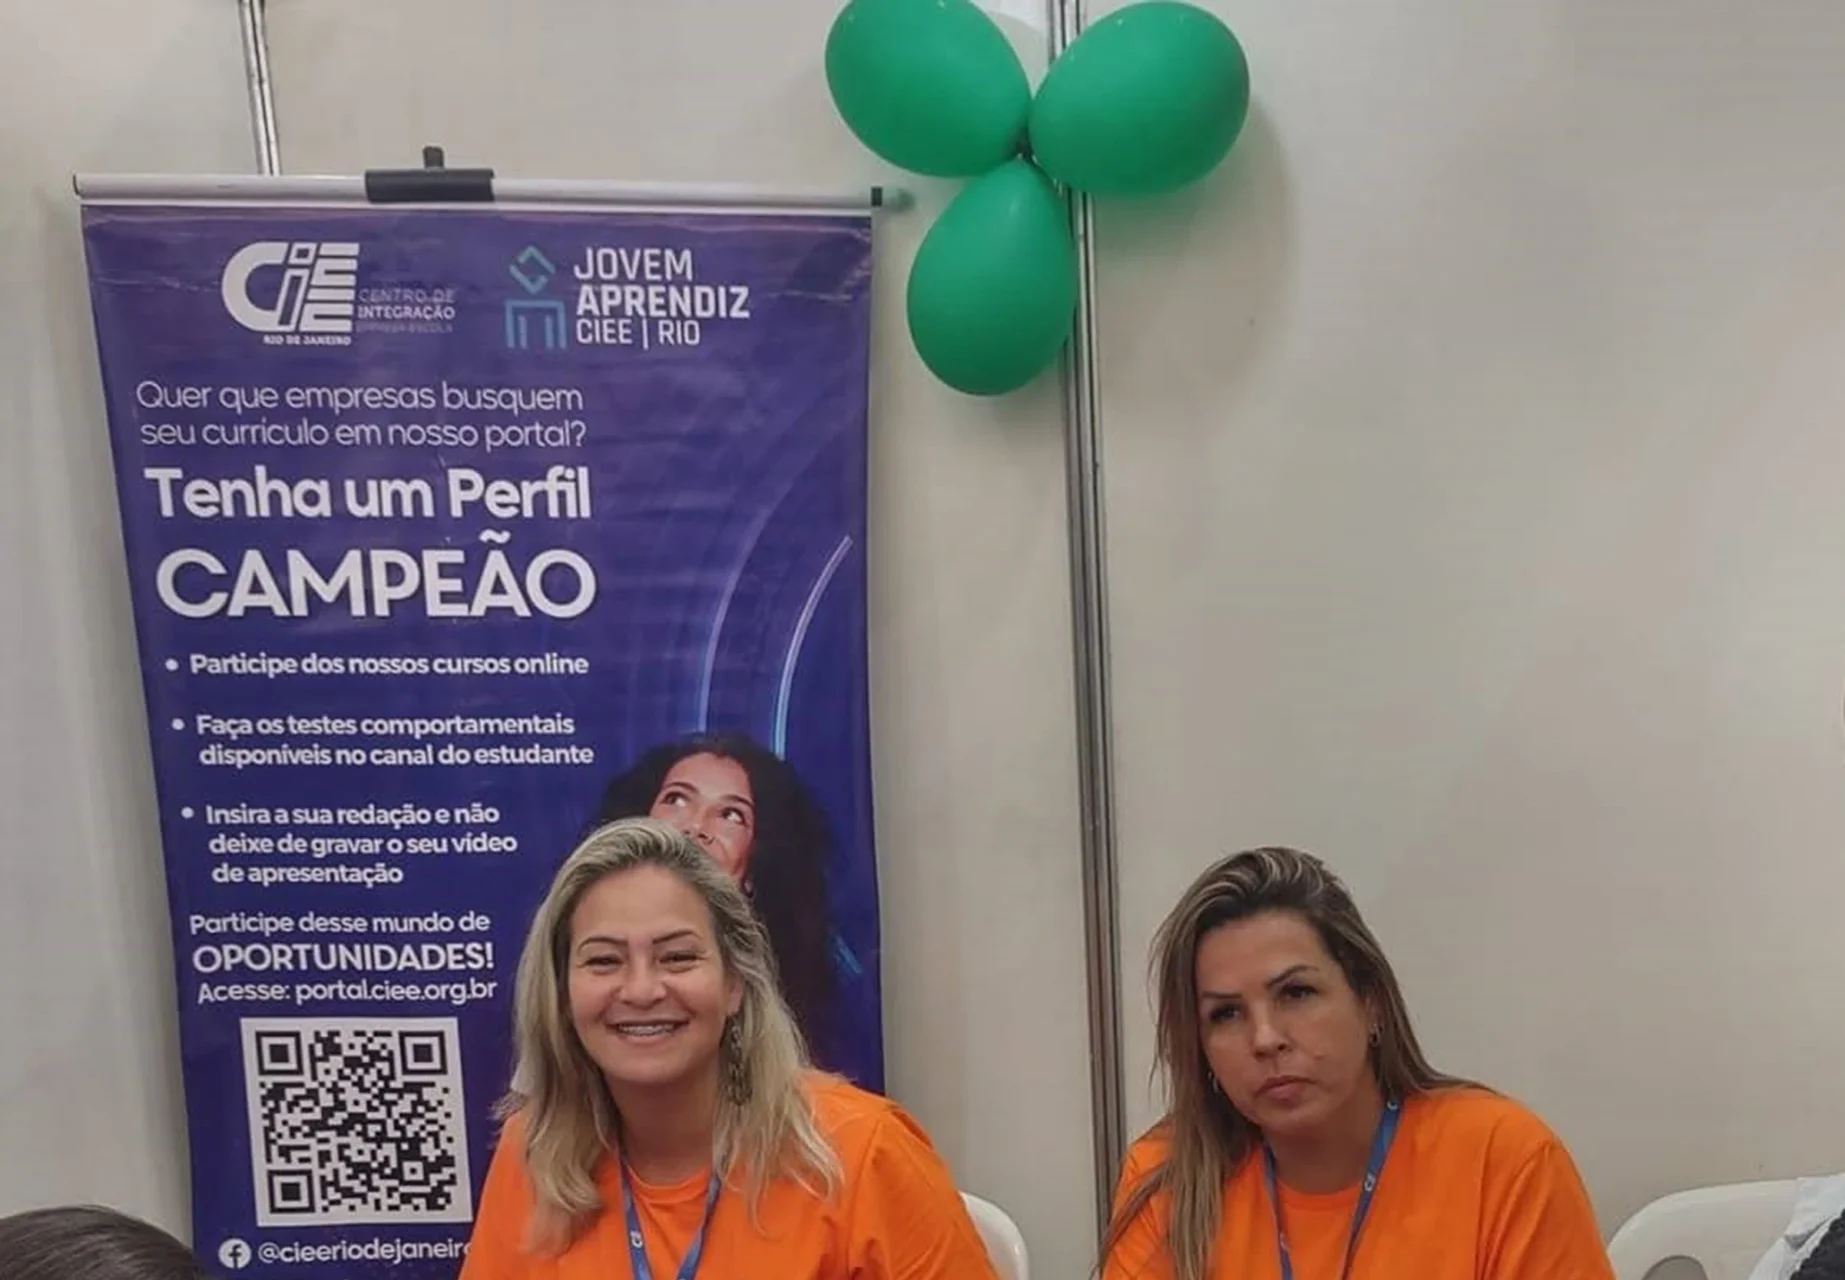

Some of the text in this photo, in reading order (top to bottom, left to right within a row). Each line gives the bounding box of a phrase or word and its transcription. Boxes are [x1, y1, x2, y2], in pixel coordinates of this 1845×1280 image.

[574, 247, 693, 281] JOVEM
[358, 288, 456, 304] CENTRO DE
[576, 284, 751, 318] APRENDIZ
[357, 305, 456, 319] INTEGRAÇÃO
[263, 335, 351, 346] RIO DE JANEIRO
[576, 318, 700, 345] CIEE RIO
[136, 380, 584, 416] Quer que empresas busquem
[140, 422, 196, 445] seu
[335, 422, 381, 446] em
[388, 422, 478, 448] nosso
[486, 419, 586, 451] portal?
[143, 465, 591, 519] Tenha um Perfil
[155, 530, 597, 618] CAMPEÃO
[190, 654, 589, 678] Participe dos nossos cursos online
[196, 713, 575, 739] Faça os testes comportamentais
[335, 747, 366, 766] no
[369, 745, 433, 766] canal
[437, 744, 471, 765] do
[474, 744, 594, 765] estudante
[206, 803, 500, 829] Insira a sua redação e não
[209, 833, 274, 854] deixe
[277, 833, 309, 853] de
[311, 837, 383, 858] gravar
[386, 837, 403, 854] o
[406, 836, 449, 853] seu
[212, 863, 404, 888] de apresentação
[190, 911, 490, 936] Participe desse mundo de
[192, 942, 495, 973] OPORTUNIDADES!
[198, 979, 498, 1006] Acesse: portal.ciee.org.br
